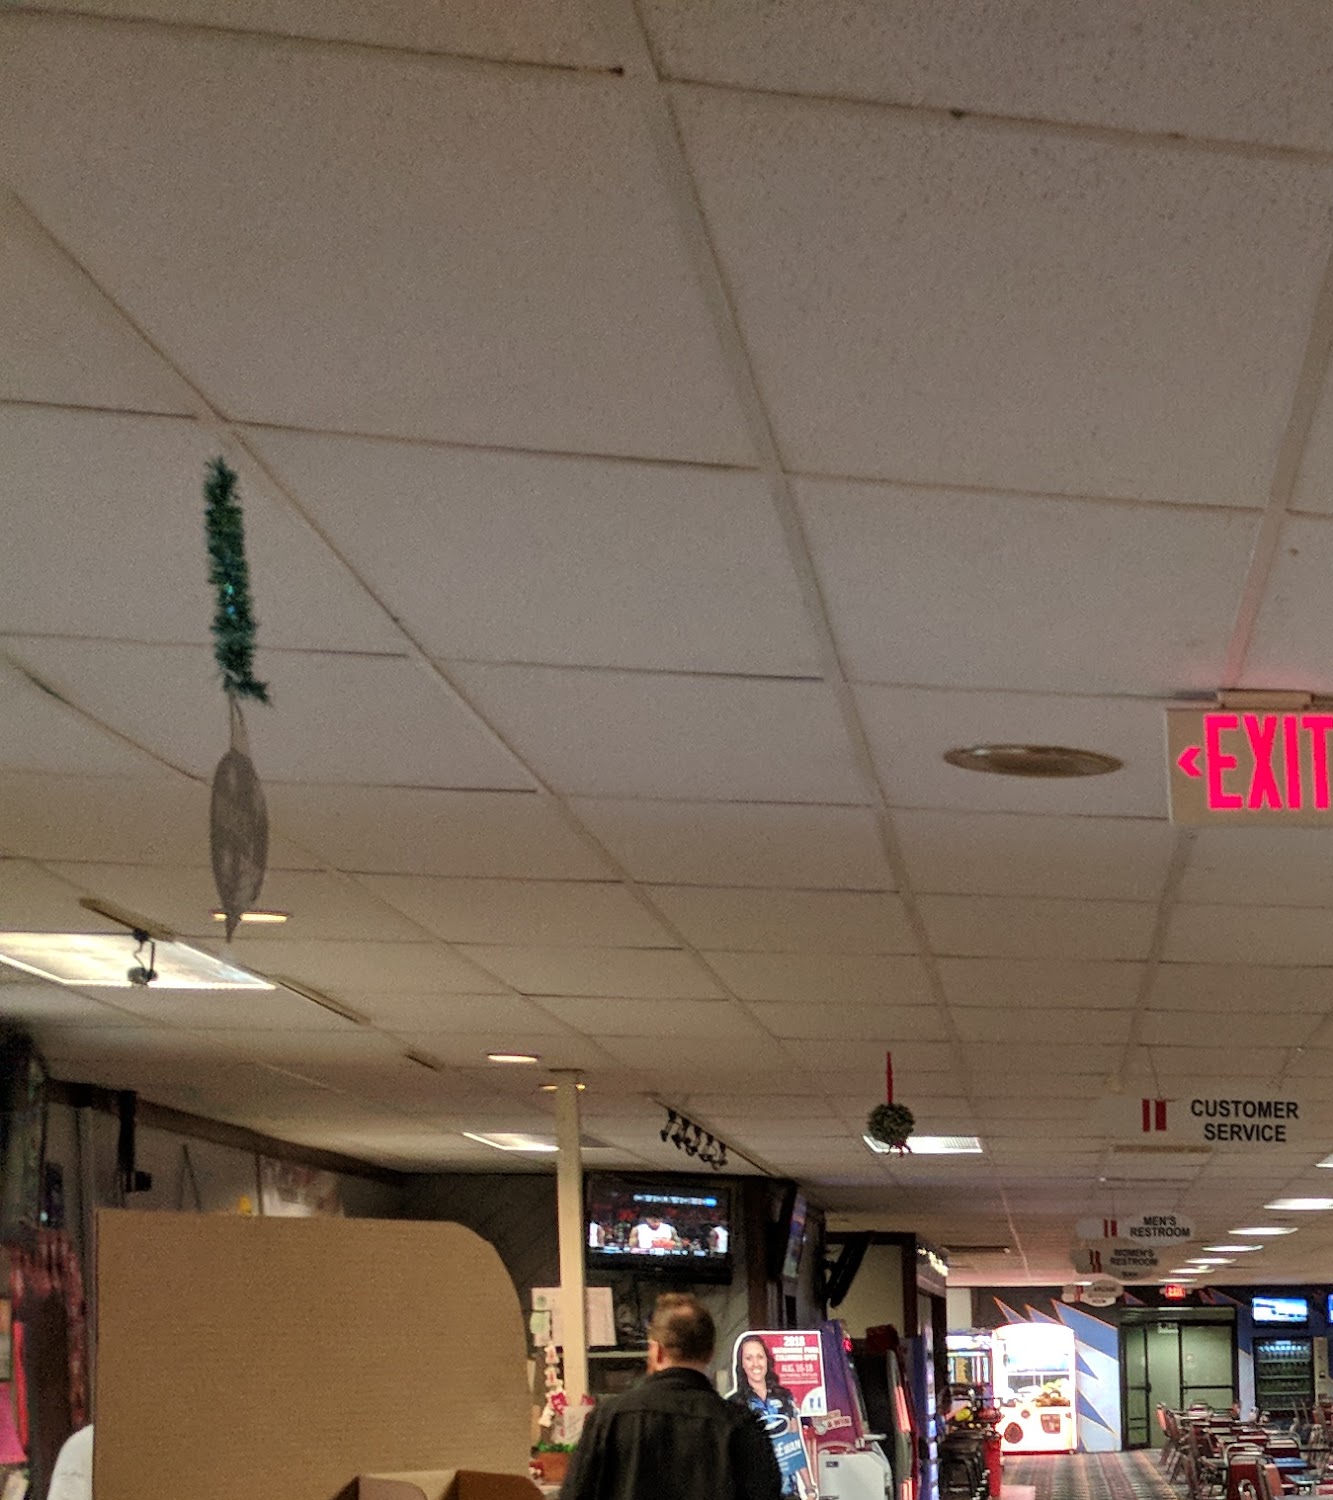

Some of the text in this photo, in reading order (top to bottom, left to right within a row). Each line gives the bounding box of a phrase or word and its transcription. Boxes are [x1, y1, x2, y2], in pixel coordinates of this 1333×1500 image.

[1190, 1099, 1299, 1119] CUSTOMER
[1204, 1123, 1287, 1143] SERVICE
[1143, 1215, 1177, 1226] MEN'S
[1129, 1226, 1190, 1238] RESTROOM
